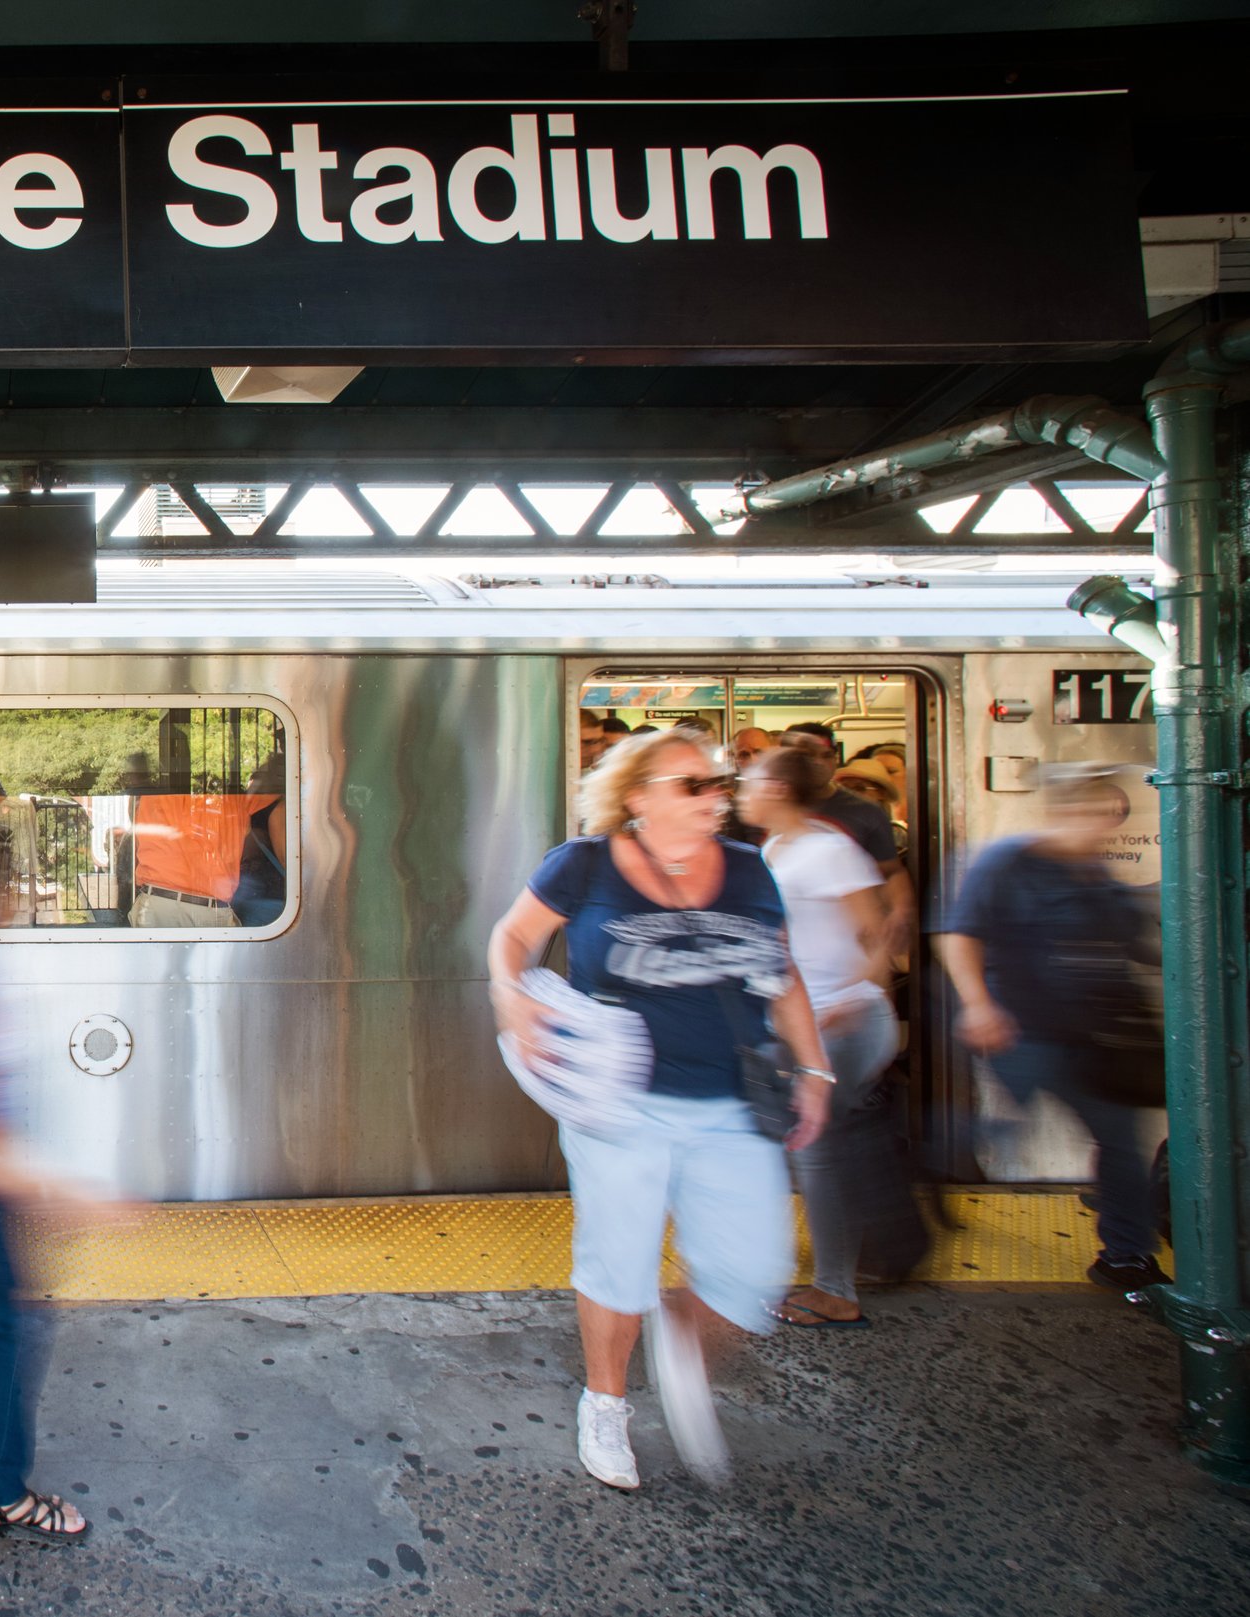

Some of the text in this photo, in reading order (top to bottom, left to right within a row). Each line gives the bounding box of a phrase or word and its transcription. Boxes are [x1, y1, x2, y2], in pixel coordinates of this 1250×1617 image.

[165, 113, 829, 249] Stadium
[1120, 834, 1150, 845] York
[1101, 849, 1142, 864] ubway
